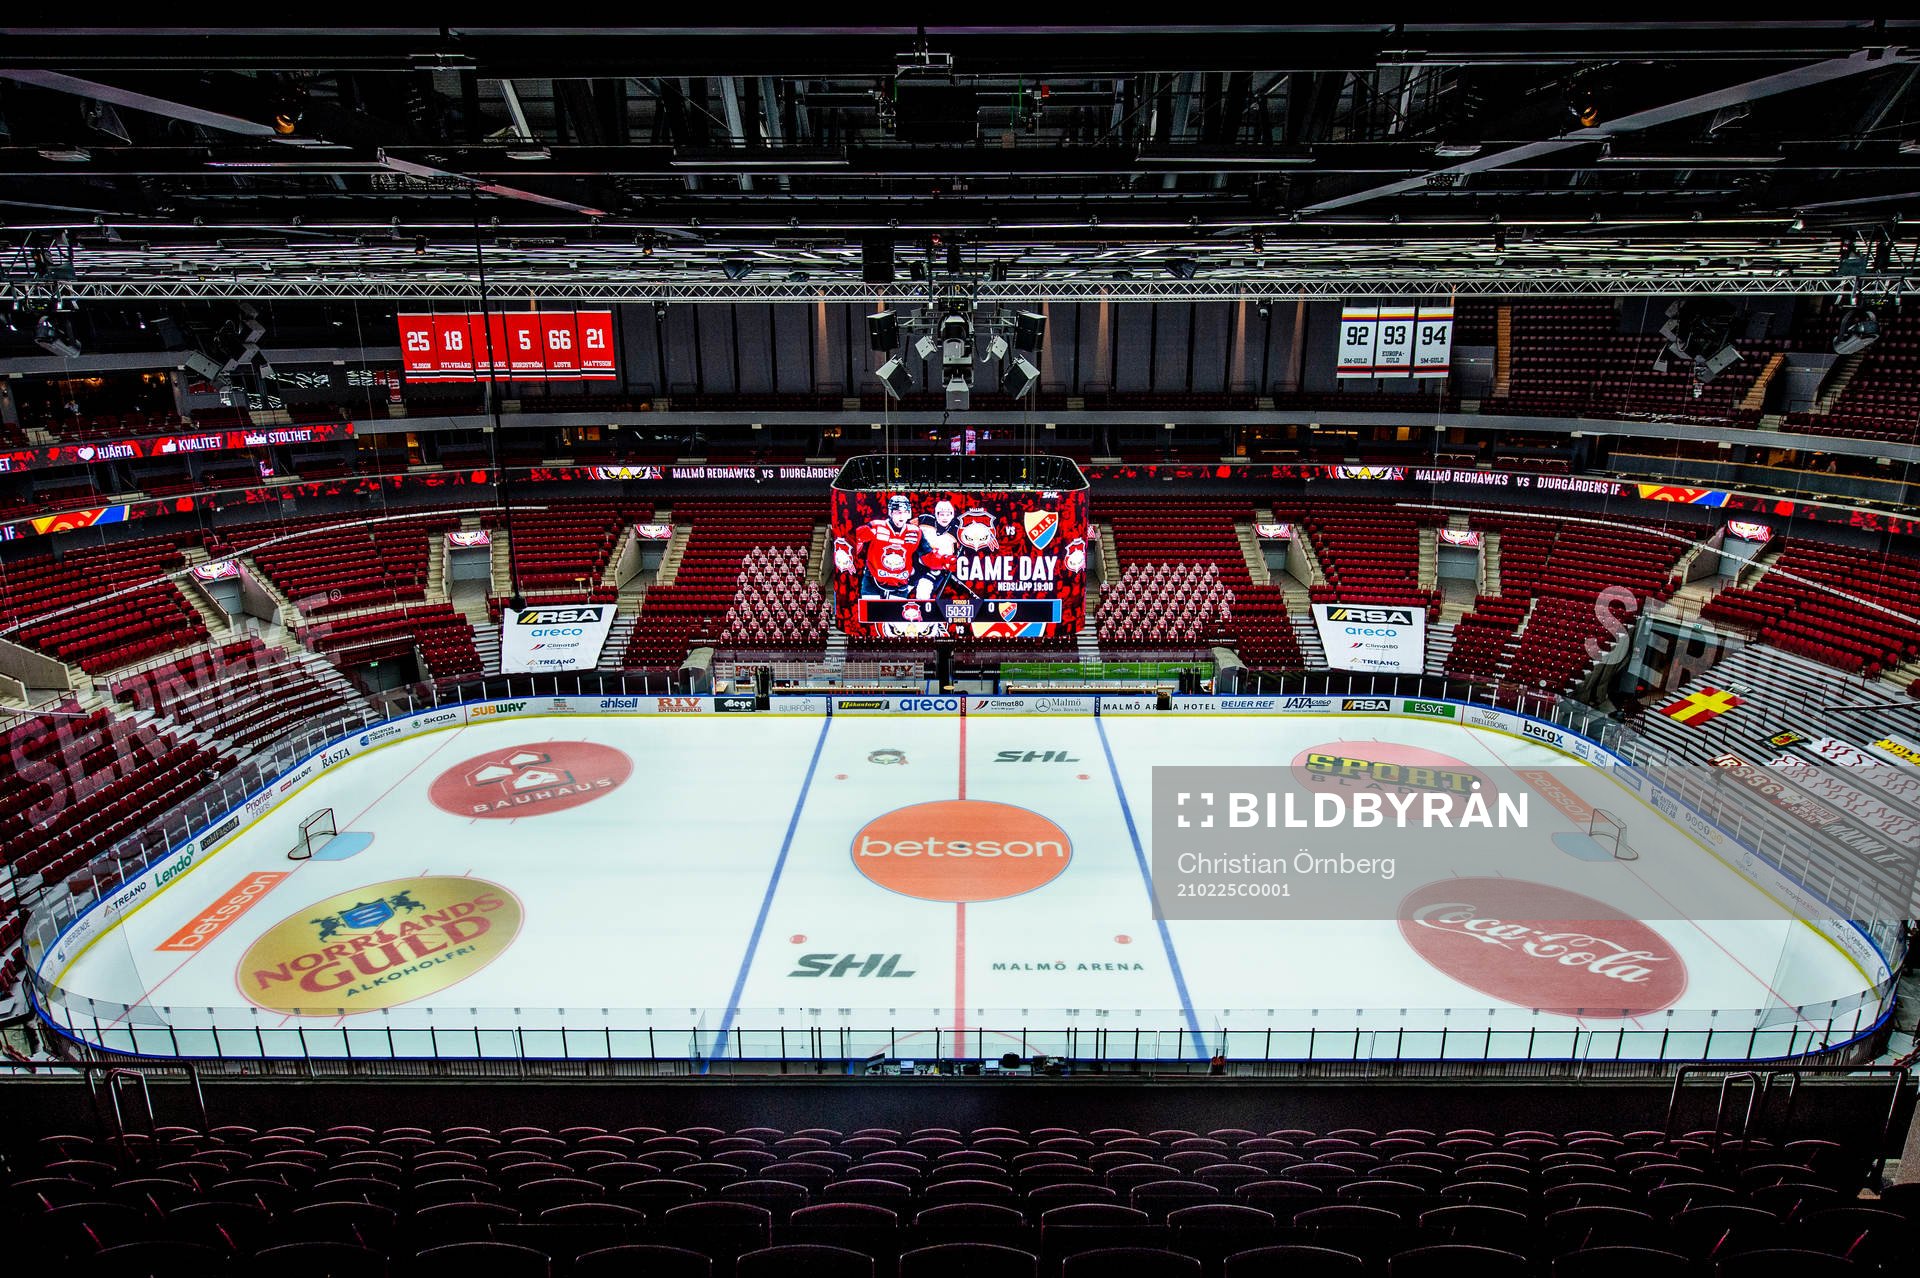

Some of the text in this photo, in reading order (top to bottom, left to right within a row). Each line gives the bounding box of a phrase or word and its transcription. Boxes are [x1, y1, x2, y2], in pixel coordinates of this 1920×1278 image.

[406, 331, 430, 351] 25
[443, 330, 463, 351] 18
[518, 330, 531, 350] 5
[548, 329, 571, 350] 66
[586, 328, 605, 349] 21
[1346, 326, 1369, 346] 92
[1383, 325, 1406, 345] 93
[1421, 325, 1447, 346] 94
[583, 359, 613, 367] MATTSSON
[178, 436, 221, 451] KVALITET
[268, 429, 312, 444] STOLTHET
[97, 444, 134, 459] HJÄRTA
[672, 465, 705, 479] MALMÖ
[706, 467, 756, 480] REDHAWKS
[779, 465, 840, 480] DJURGÅRDENS
[1415, 467, 1451, 482] MALMÖ
[1453, 471, 1509, 486] REDHAWKS
[1536, 475, 1609, 495] DJURGÅRDENS
[1610, 483, 1622, 496] IF
[956, 555, 1058, 581] GAME DAY
[997, 581, 1054, 592] NEDSLÄPP 19:00
[536, 610, 600, 624] RSA
[947, 606, 972, 617] 50:37
[1345, 609, 1412, 625] RSA
[530, 627, 584, 637] areco
[1344, 626, 1398, 638] areco
[538, 658, 576, 666] TREANO
[1361, 658, 1401, 667] TREANO
[471, 701, 527, 717] SUBWAY
[600, 697, 639, 709] ahlsell
[657, 697, 702, 707] RIV
[778, 704, 816, 712] BJURFORS
[899, 698, 959, 712] areco
[1051, 697, 1082, 706] Malmö
[1102, 701, 1141, 711] MALMÖ
[1220, 700, 1275, 708] BEIJER REF
[1282, 697, 1312, 709] JATA
[1352, 700, 1389, 711] RSA
[1414, 703, 1444, 715] ESSVE
[1470, 716, 1509, 731] TRELLEBORG
[1522, 719, 1566, 744] bergx
[321, 747, 351, 769] RASTA
[992, 750, 1081, 763] SHL
[292, 766, 313, 784] ALL OUT
[1305, 753, 1481, 795] SPORT
[245, 788, 273, 814] Prioritet
[472, 777, 614, 815] BAUHAUS
[859, 835, 1064, 858] betsson
[154, 856, 192, 888] Lendo
[112, 881, 148, 910] TREANO
[168, 872, 279, 949] betsson
[252, 891, 506, 991] NORRLANDS
[1412, 902, 1672, 984] Coca-Cola
[298, 914, 493, 994] GULD
[345, 944, 477, 997] ALKOHOLFRI
[785, 953, 917, 978] SHL
[991, 960, 1145, 972] MALMÖ ARENA
